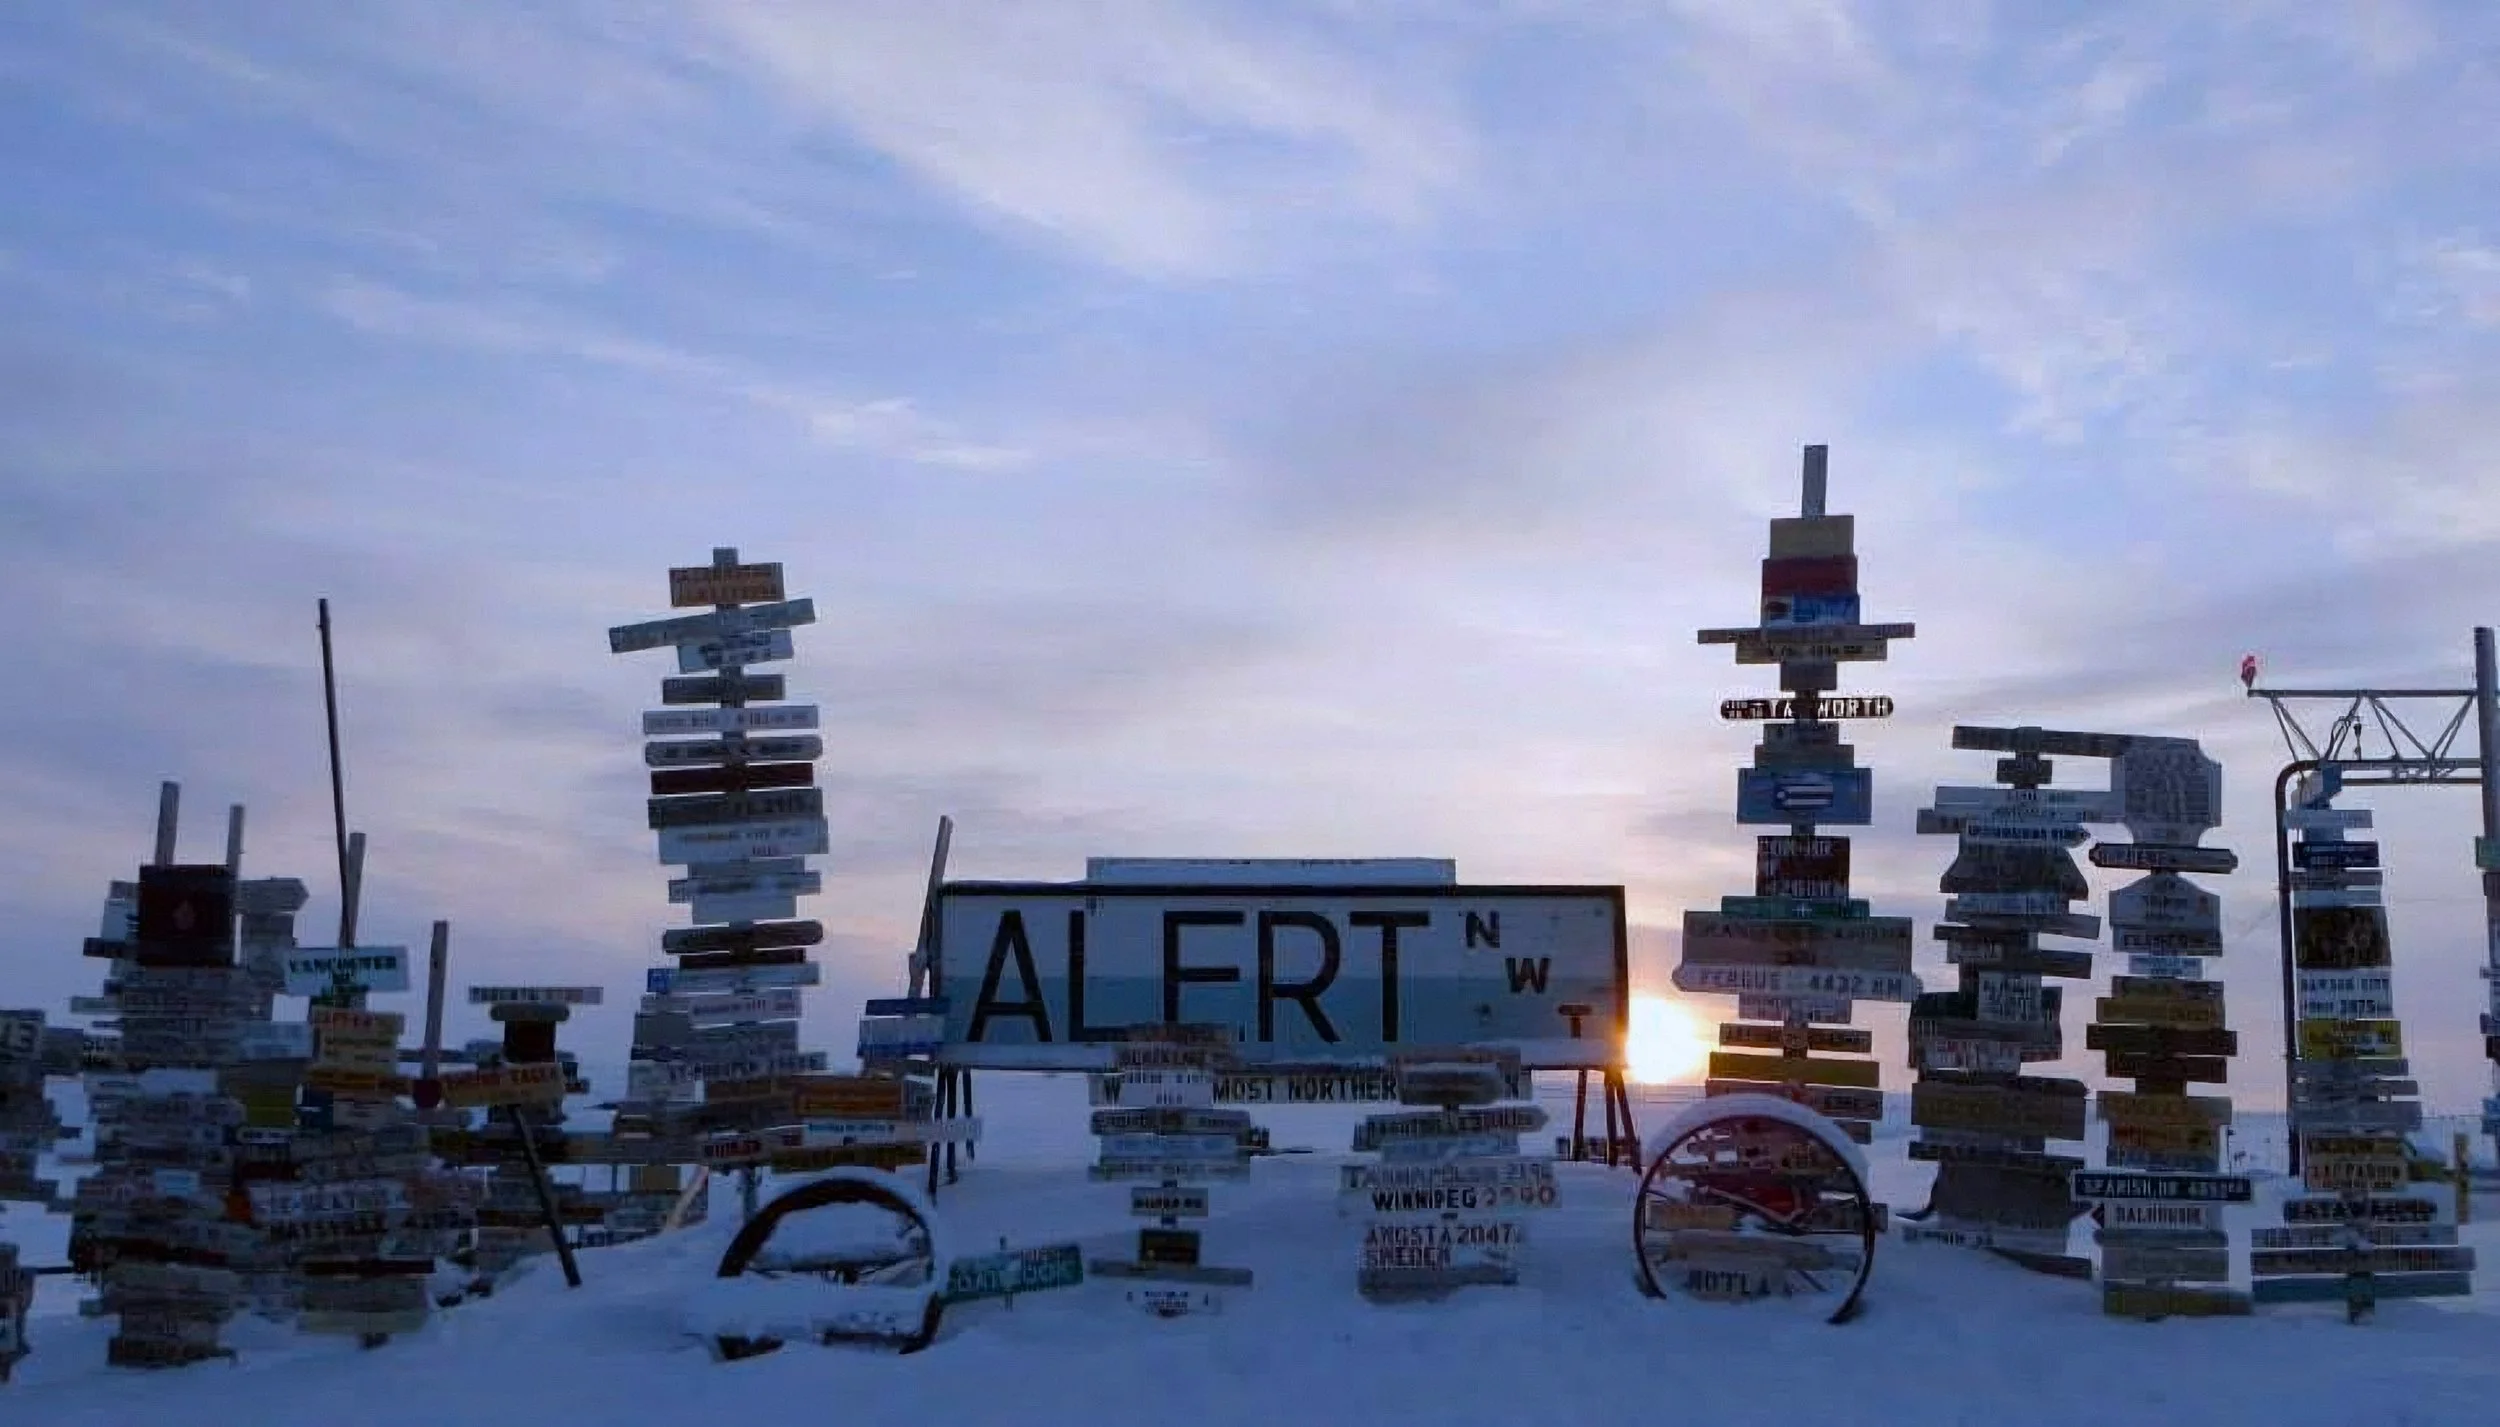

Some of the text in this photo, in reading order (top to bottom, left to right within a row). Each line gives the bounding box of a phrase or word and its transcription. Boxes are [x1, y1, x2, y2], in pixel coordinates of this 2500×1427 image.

[1769, 698, 1888, 718] TAWORTH
[966, 909, 1430, 1044] ALERT
[1465, 911, 1592, 1039] N W T
[1212, 1076, 1273, 1103] MOST
[1288, 1074, 1398, 1103] NORTHER
[1372, 1187, 1477, 1211] WINNIPEG
